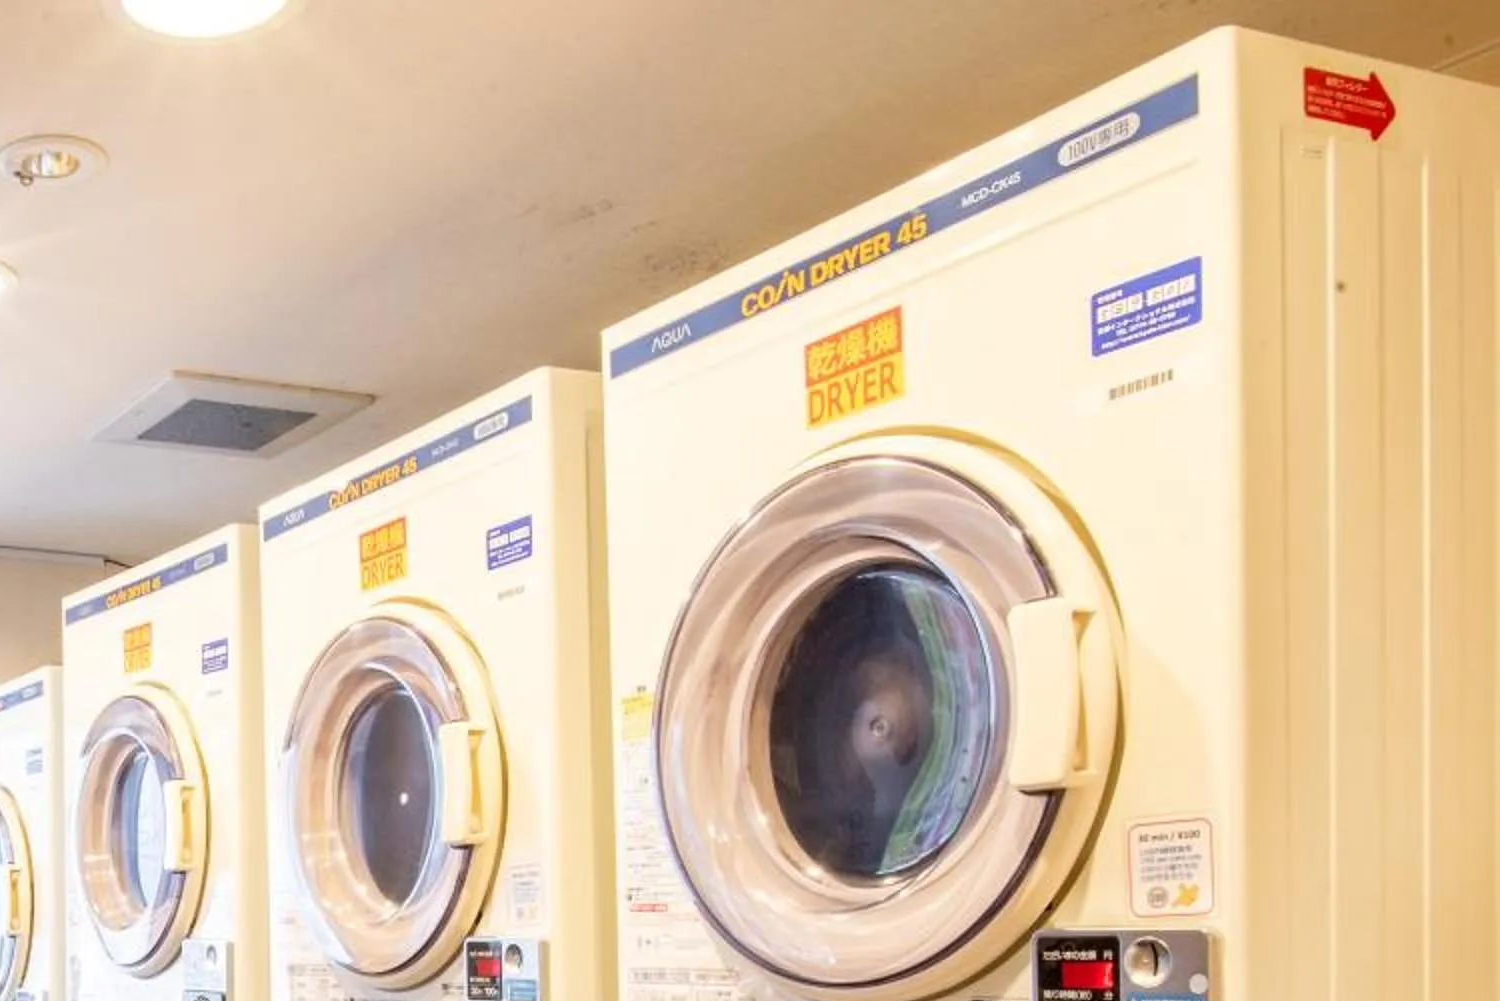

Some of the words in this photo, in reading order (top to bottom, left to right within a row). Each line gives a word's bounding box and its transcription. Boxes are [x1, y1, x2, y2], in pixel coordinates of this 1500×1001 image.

[810, 231, 891, 288] DRYER
[896, 213, 928, 246] 45
[808, 361, 898, 426] DRYER
[361, 552, 405, 591] DRYER
